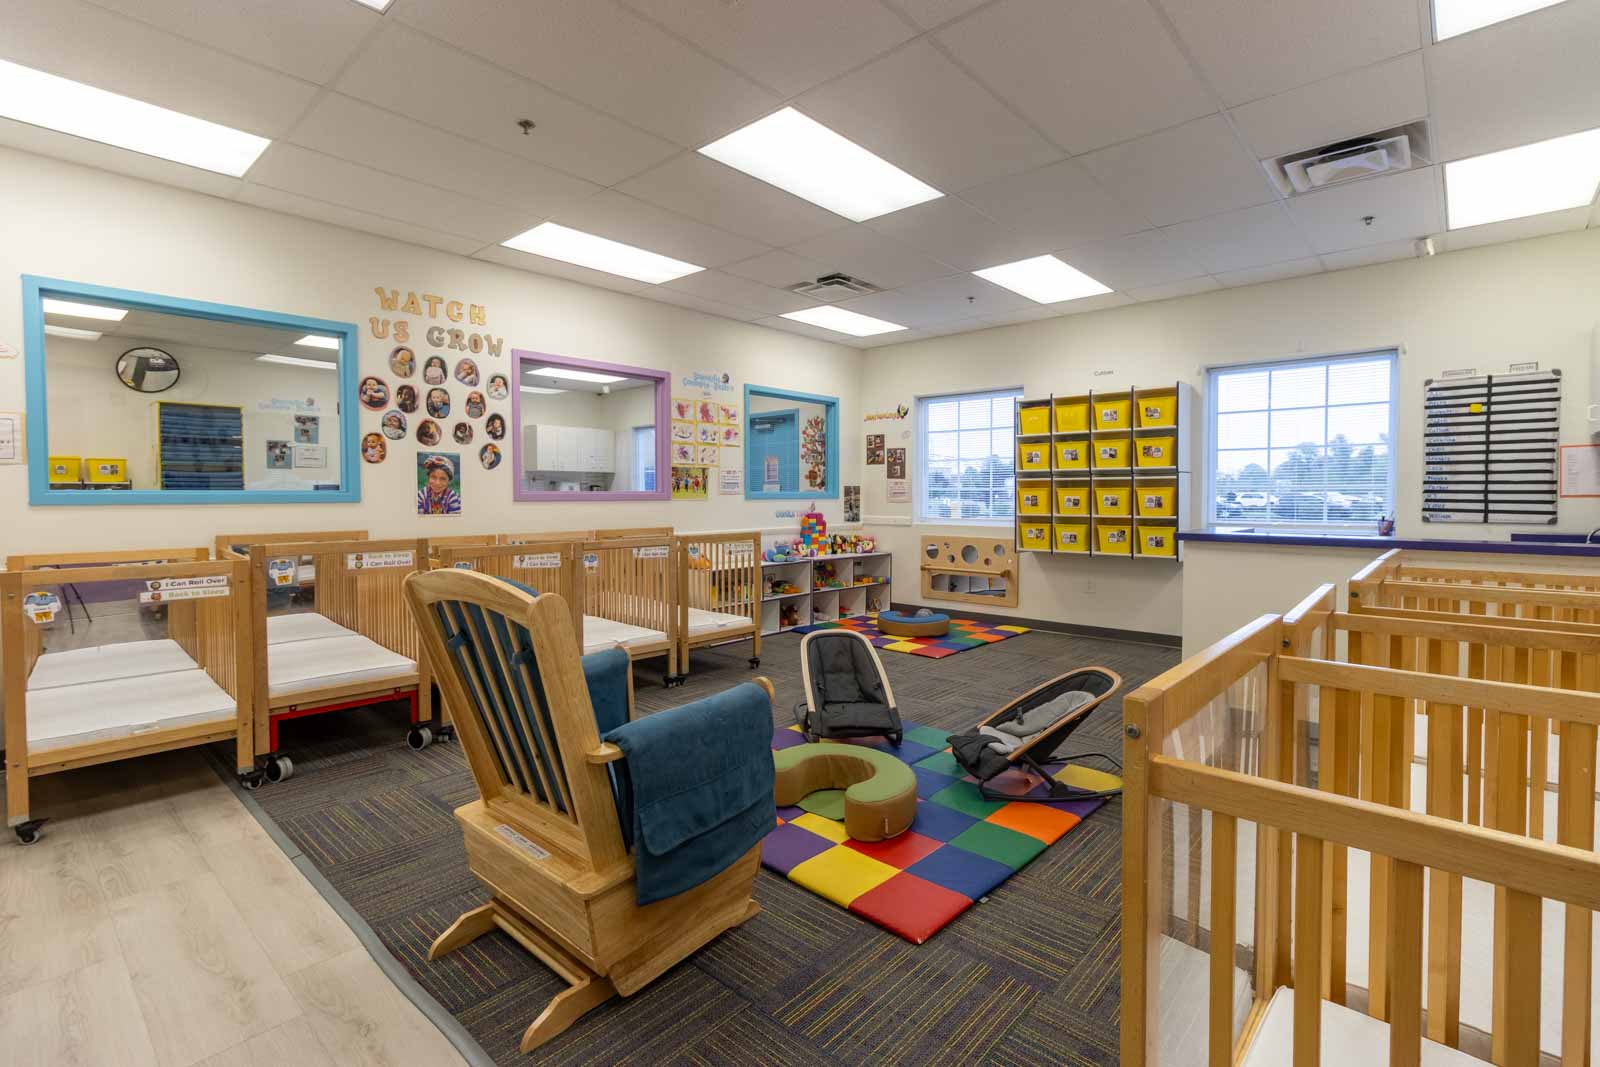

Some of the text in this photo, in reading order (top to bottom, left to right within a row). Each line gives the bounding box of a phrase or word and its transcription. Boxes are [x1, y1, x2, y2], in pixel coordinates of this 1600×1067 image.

[375, 286, 487, 326] WATCH
[368, 316, 504, 358] US GROW
[169, 590, 188, 598] Back
[170, 580, 187, 588] Can
[206, 577, 225, 585] Over
